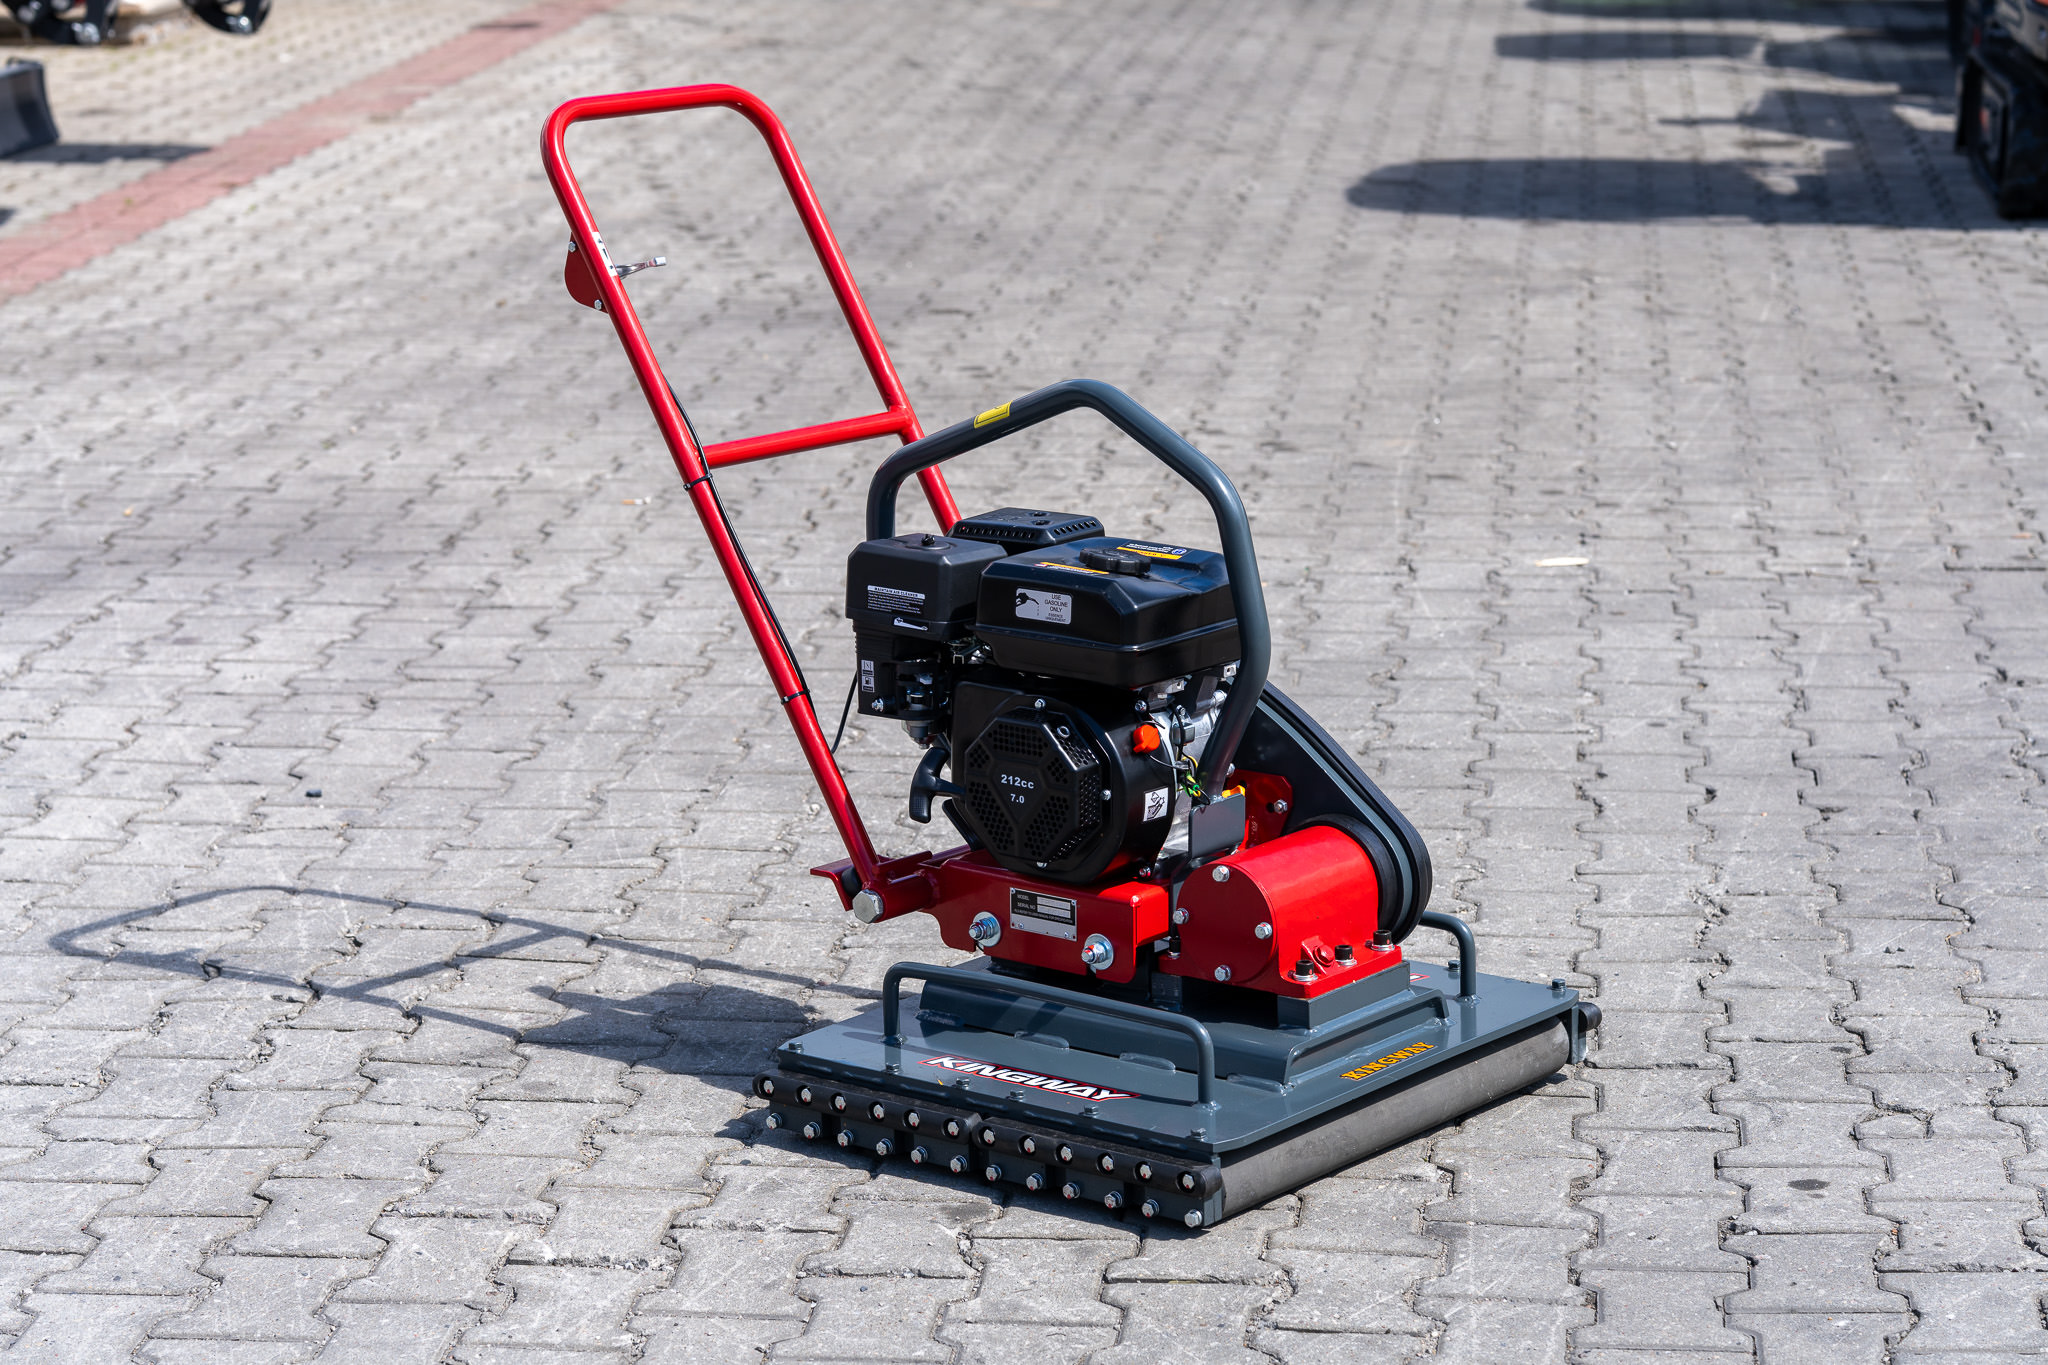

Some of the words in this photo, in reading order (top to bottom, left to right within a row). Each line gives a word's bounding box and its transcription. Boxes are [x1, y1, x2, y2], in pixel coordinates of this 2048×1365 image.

[1001, 774, 1034, 789] 212cc
[1010, 793, 1025, 804] 7.0
[1340, 1041, 1435, 1080] KINGWAY
[924, 1055, 1136, 1101] KINGWAY
